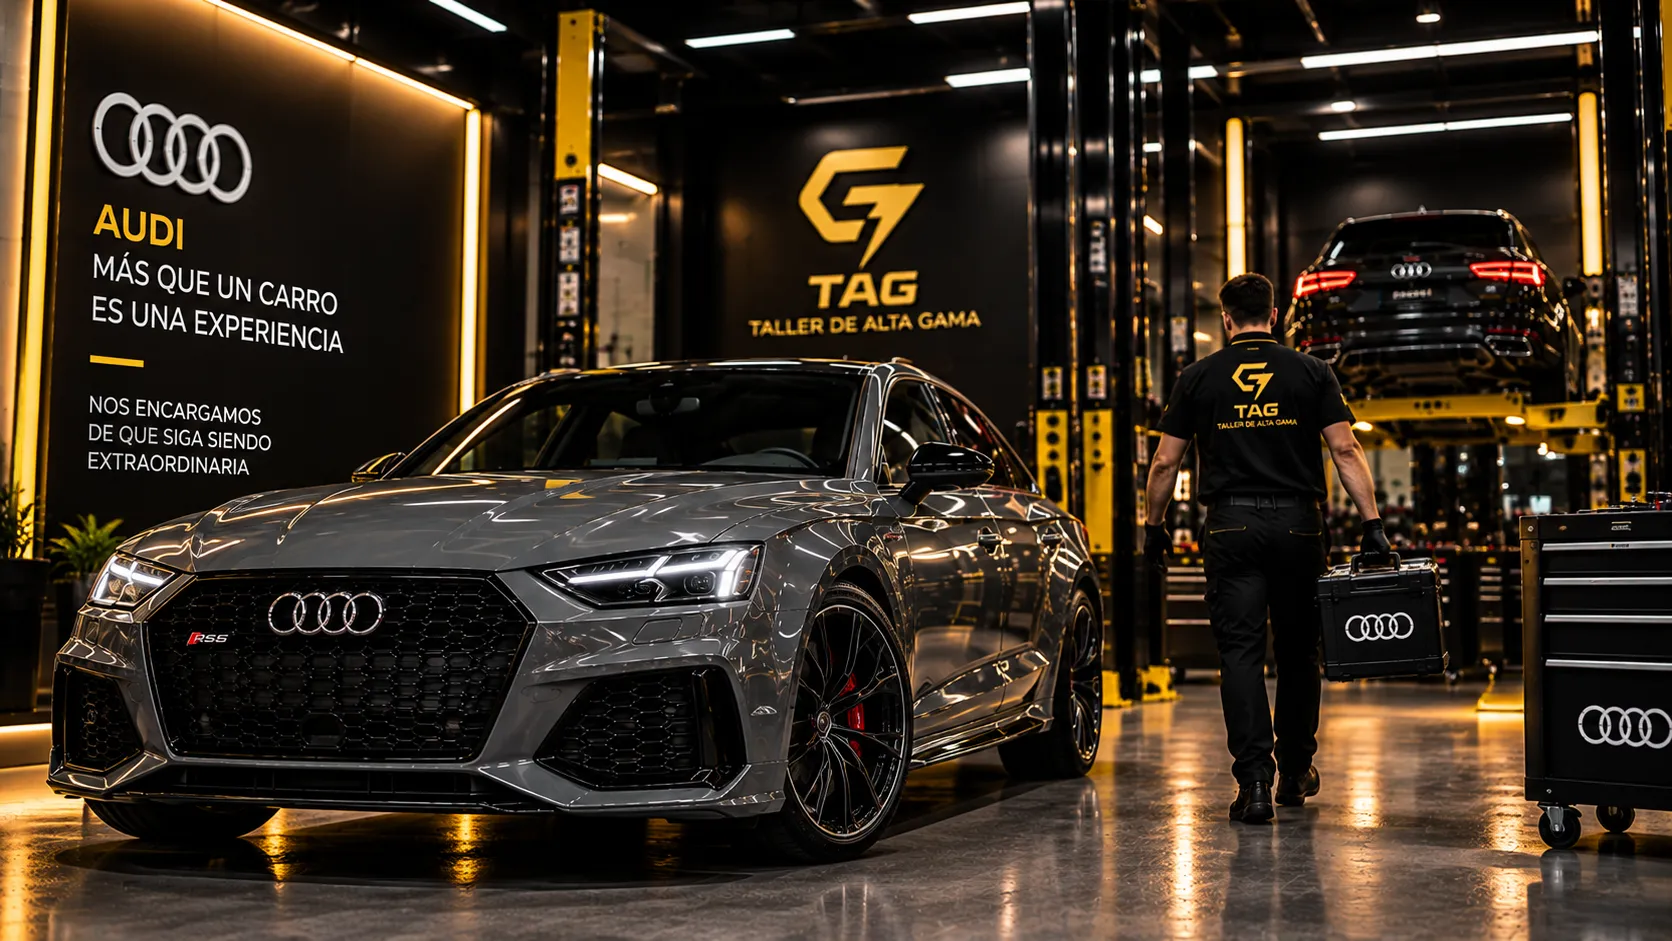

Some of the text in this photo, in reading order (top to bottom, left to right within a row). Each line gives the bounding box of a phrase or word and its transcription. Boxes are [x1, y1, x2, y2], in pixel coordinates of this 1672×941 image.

[93, 204, 183, 250] AUDI
[94, 252, 337, 315] MÁS QUE UN CARRO
[808, 271, 918, 308] TAG
[93, 296, 343, 353] ES UNA EXPERIENCIA
[749, 311, 981, 336] TALLER DE ALTA GAMA
[90, 396, 261, 425] NOS ENCARGAMOS
[1217, 422, 1244, 430] TALLER
[1275, 418, 1298, 426] GAMA
[1234, 403, 1278, 418] TAG
[89, 424, 271, 451] DE QUE SIGA SIENDO
[88, 452, 249, 475] EXTRAORDINARIA
